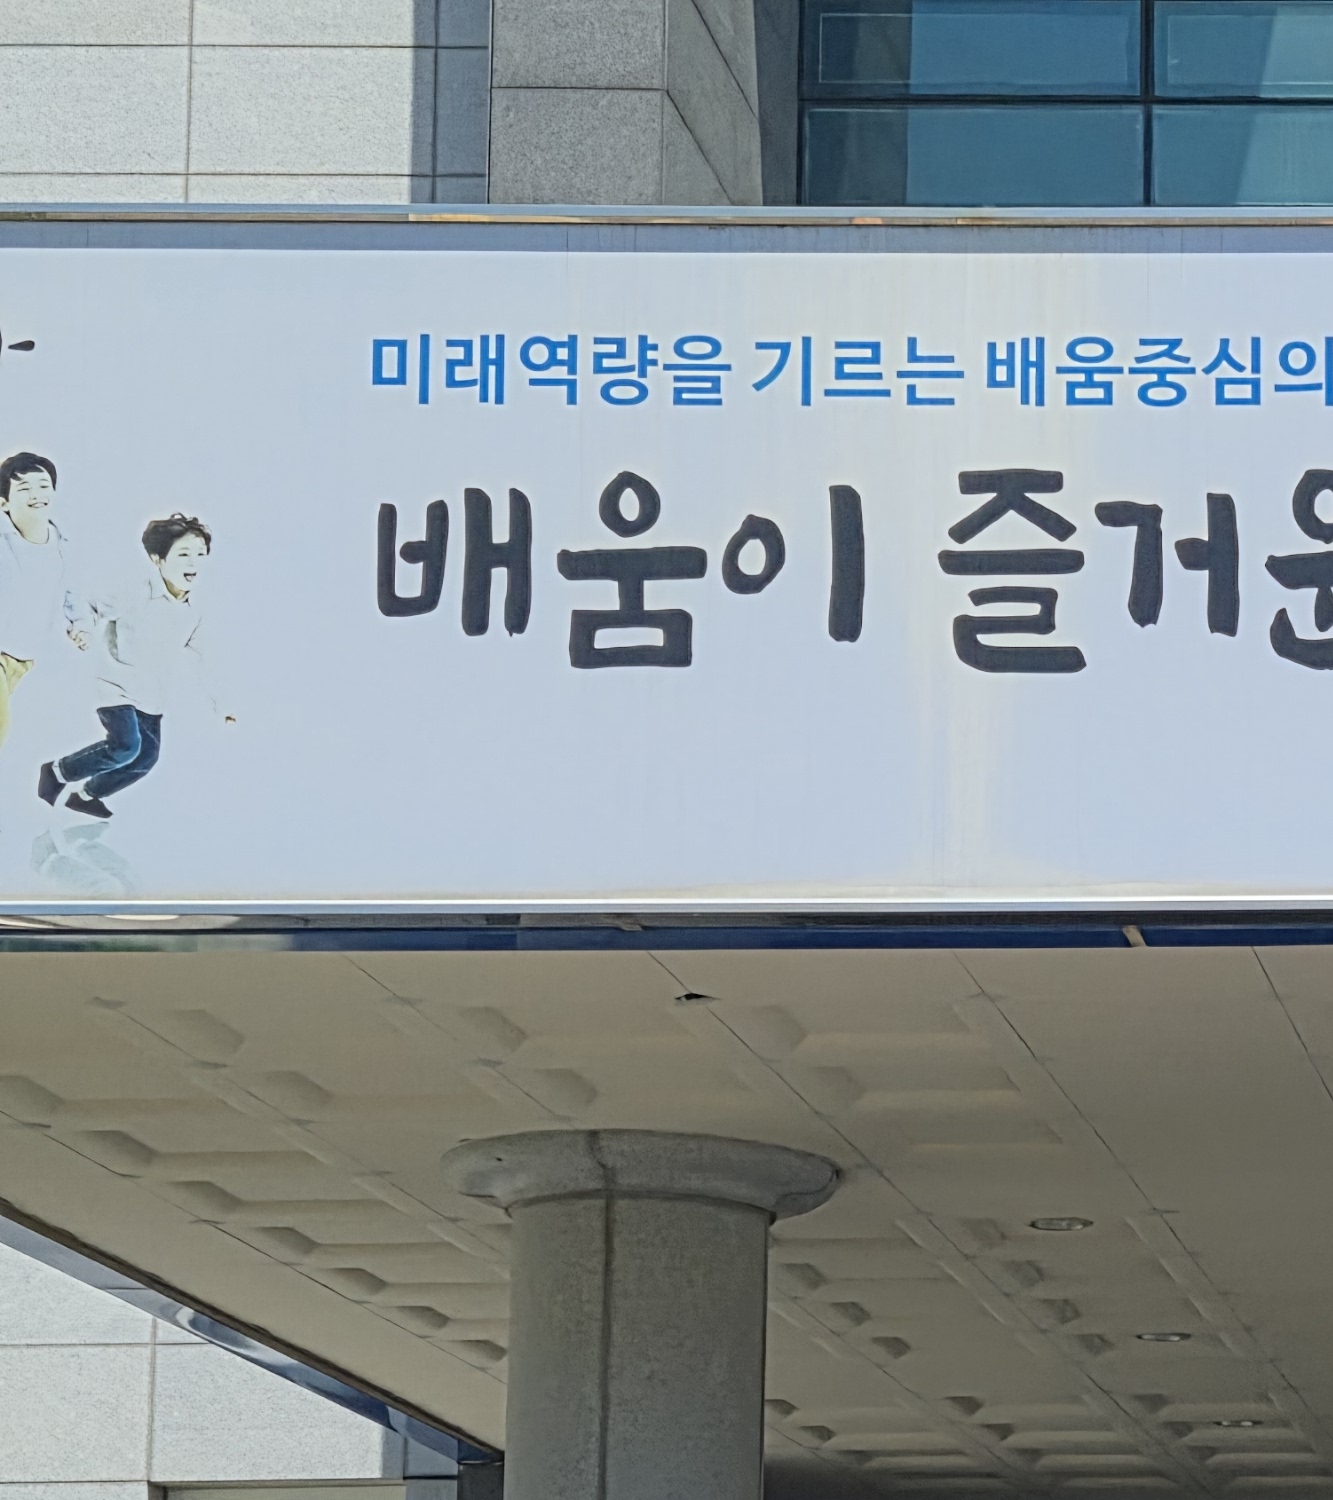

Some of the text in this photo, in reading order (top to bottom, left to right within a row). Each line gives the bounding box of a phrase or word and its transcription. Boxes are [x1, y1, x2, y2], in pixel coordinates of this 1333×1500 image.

[371, 333, 732, 408] 미래역량을
[752, 335, 966, 408] 기르는
[376, 470, 866, 670] 배움이
